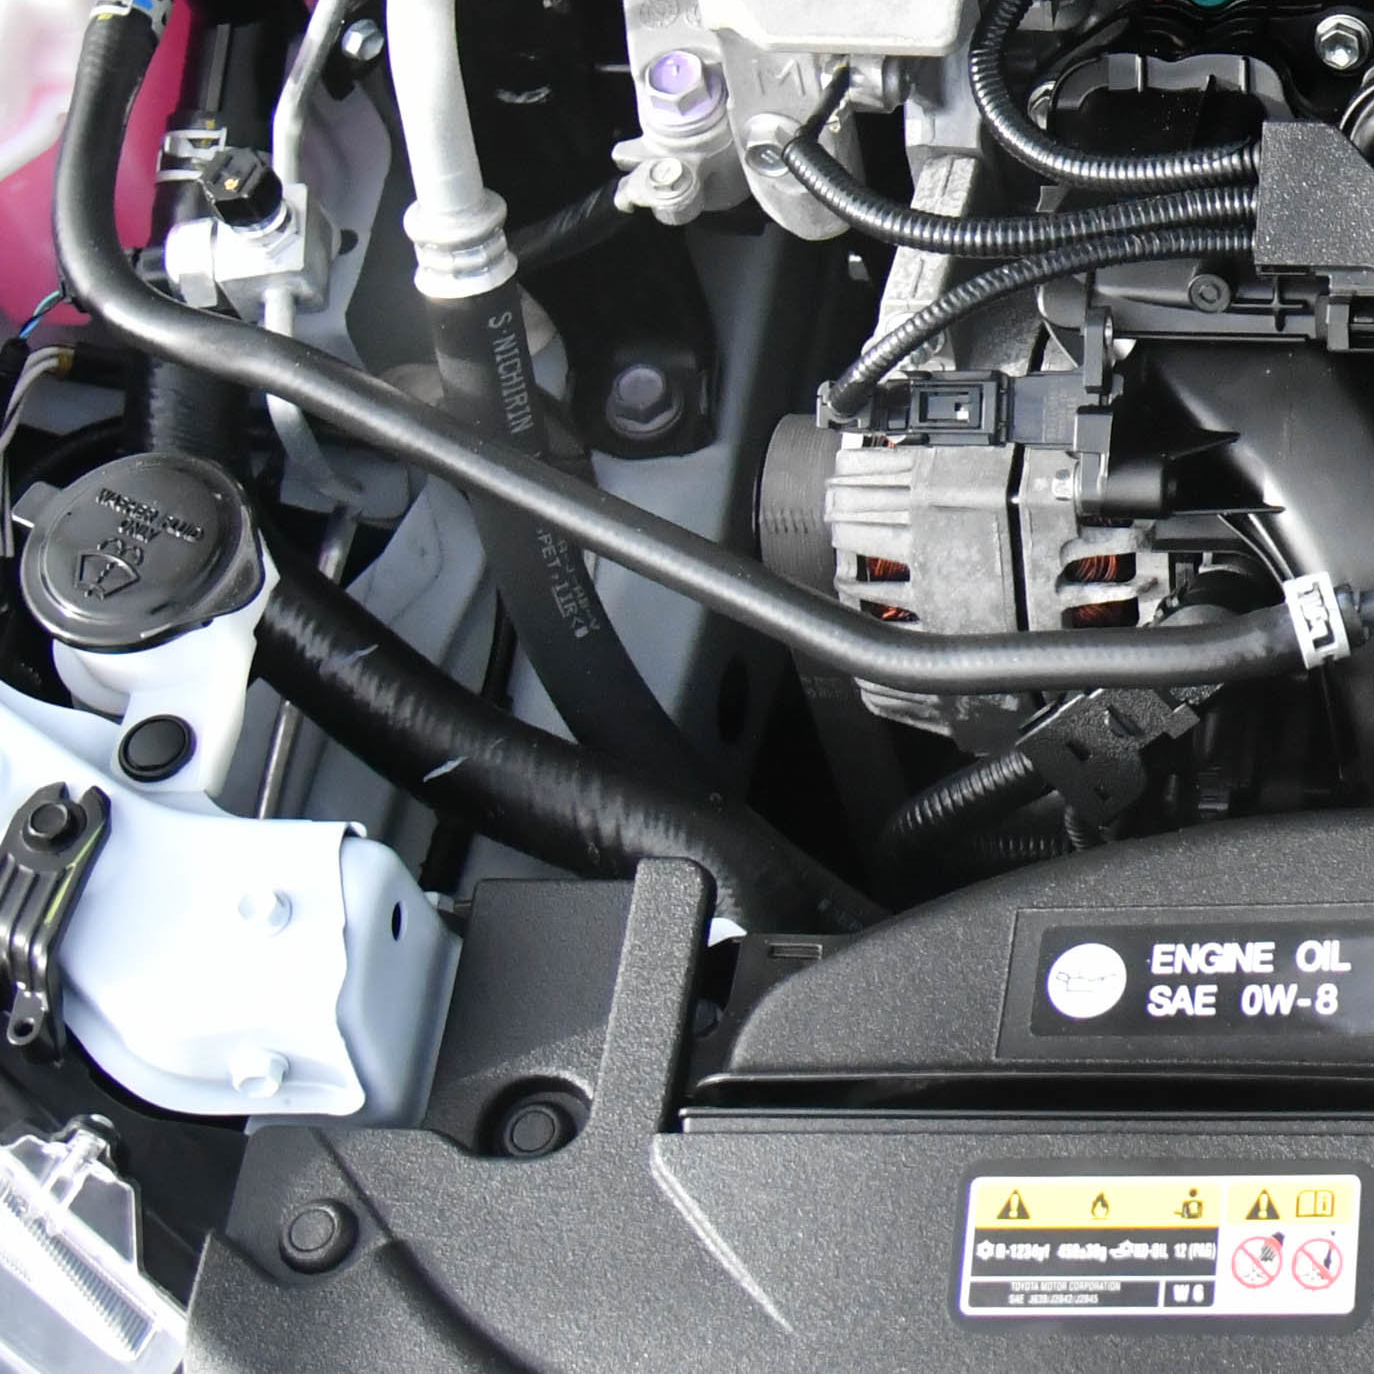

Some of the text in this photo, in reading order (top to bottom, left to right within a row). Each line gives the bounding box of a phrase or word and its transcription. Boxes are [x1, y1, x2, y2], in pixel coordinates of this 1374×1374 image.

[1151, 940, 1352, 974] ENGINE OIL
[1147, 983, 1338, 1016] SAE 0W-8
[1011, 1281, 1122, 1291] TOYOTA MOTOR CORPORATION
[1008, 1294, 1025, 1305] SAE
